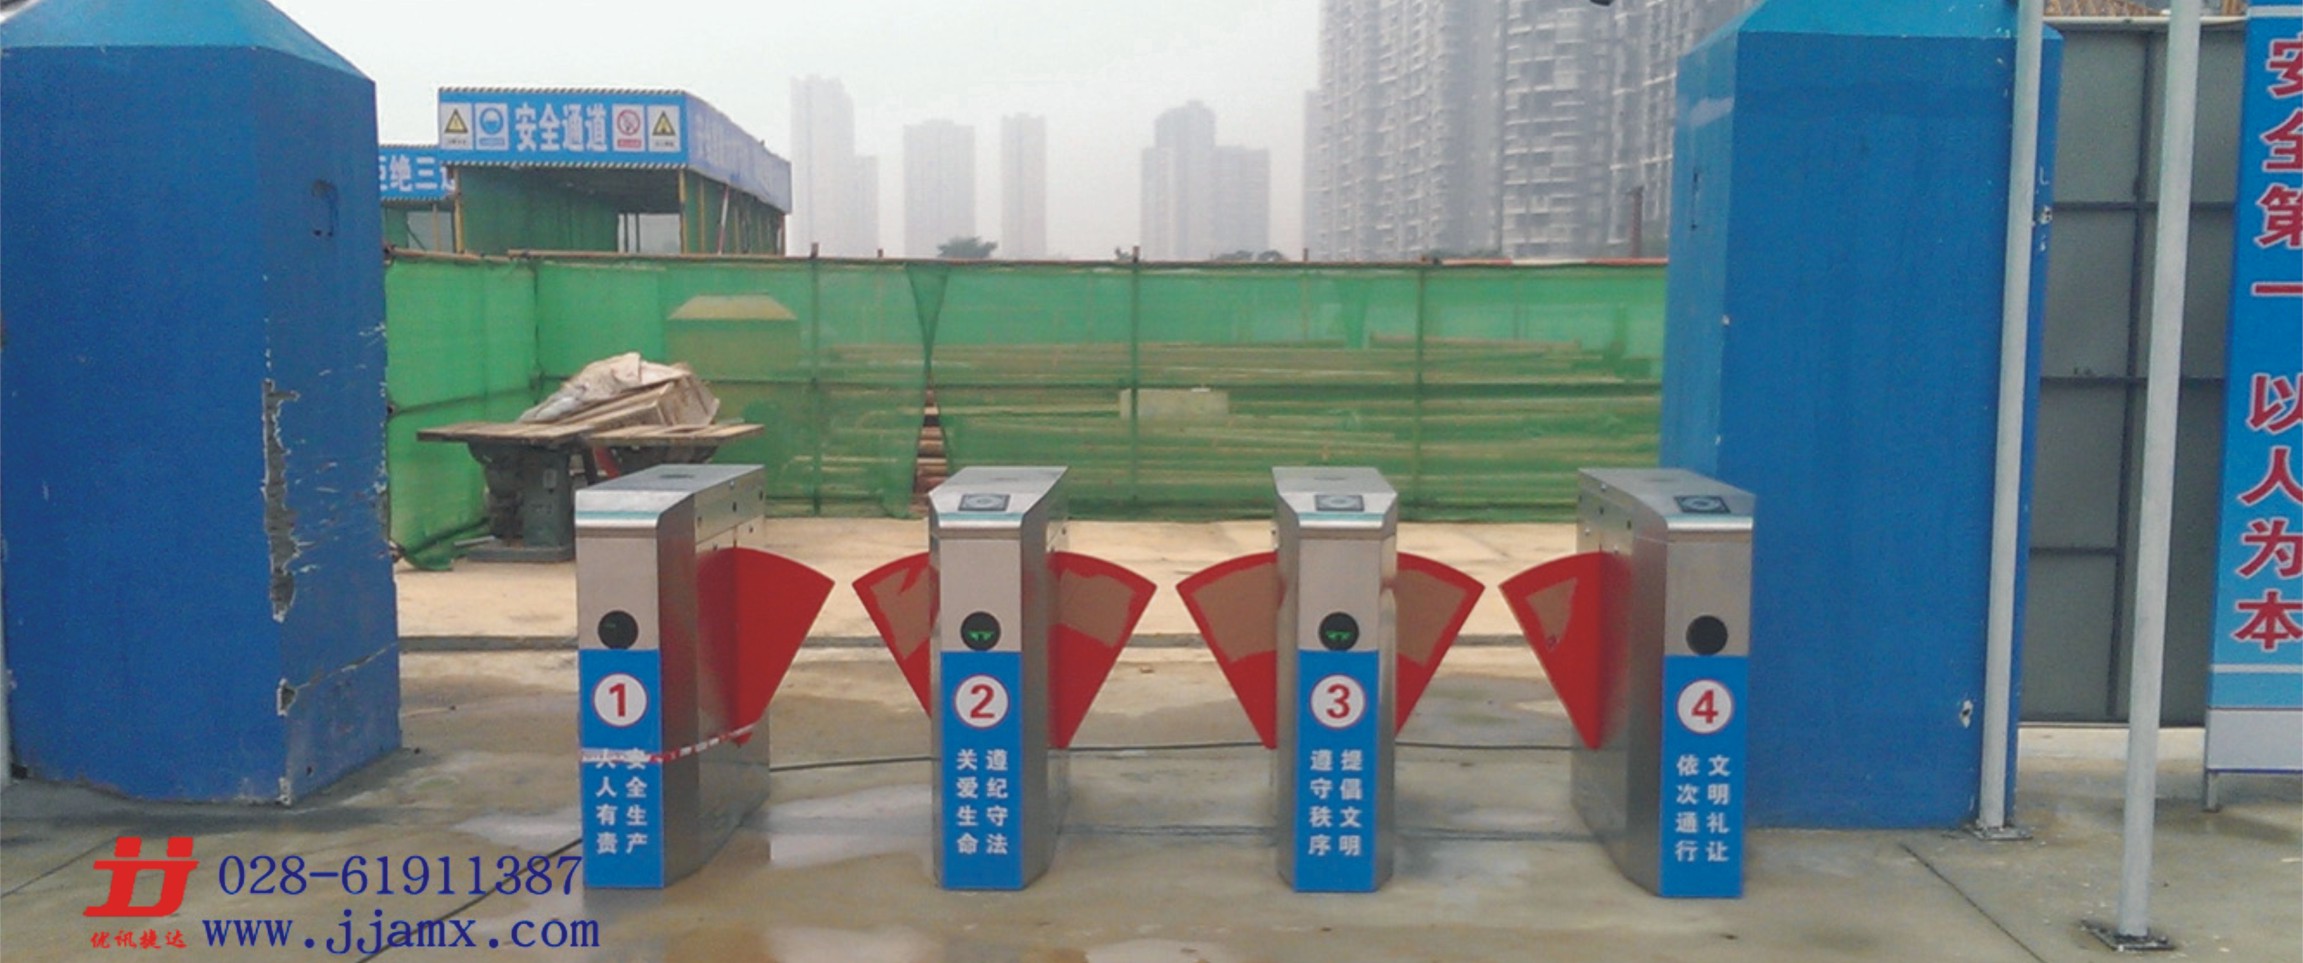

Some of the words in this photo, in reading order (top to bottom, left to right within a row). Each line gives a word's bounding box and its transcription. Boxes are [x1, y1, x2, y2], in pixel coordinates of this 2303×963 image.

[515, 102, 608, 152] 安全通道
[2232, 373, 2303, 651] 以人为本
[609, 682, 627, 717] 1
[970, 683, 995, 719] 2
[1326, 683, 1351, 719] 3
[1691, 689, 1719, 725] 4
[596, 748, 618, 854] 人人有责
[626, 748, 648, 854] 安全生产
[956, 749, 979, 855] 关爱生命
[986, 749, 1009, 855] 遵纪守法
[1309, 750, 1332, 856] 遵守秩序
[1339, 750, 1363, 856] 提倡文明
[1675, 755, 1699, 862] 依次通行
[1706, 755, 1730, 862] 文明礼让
